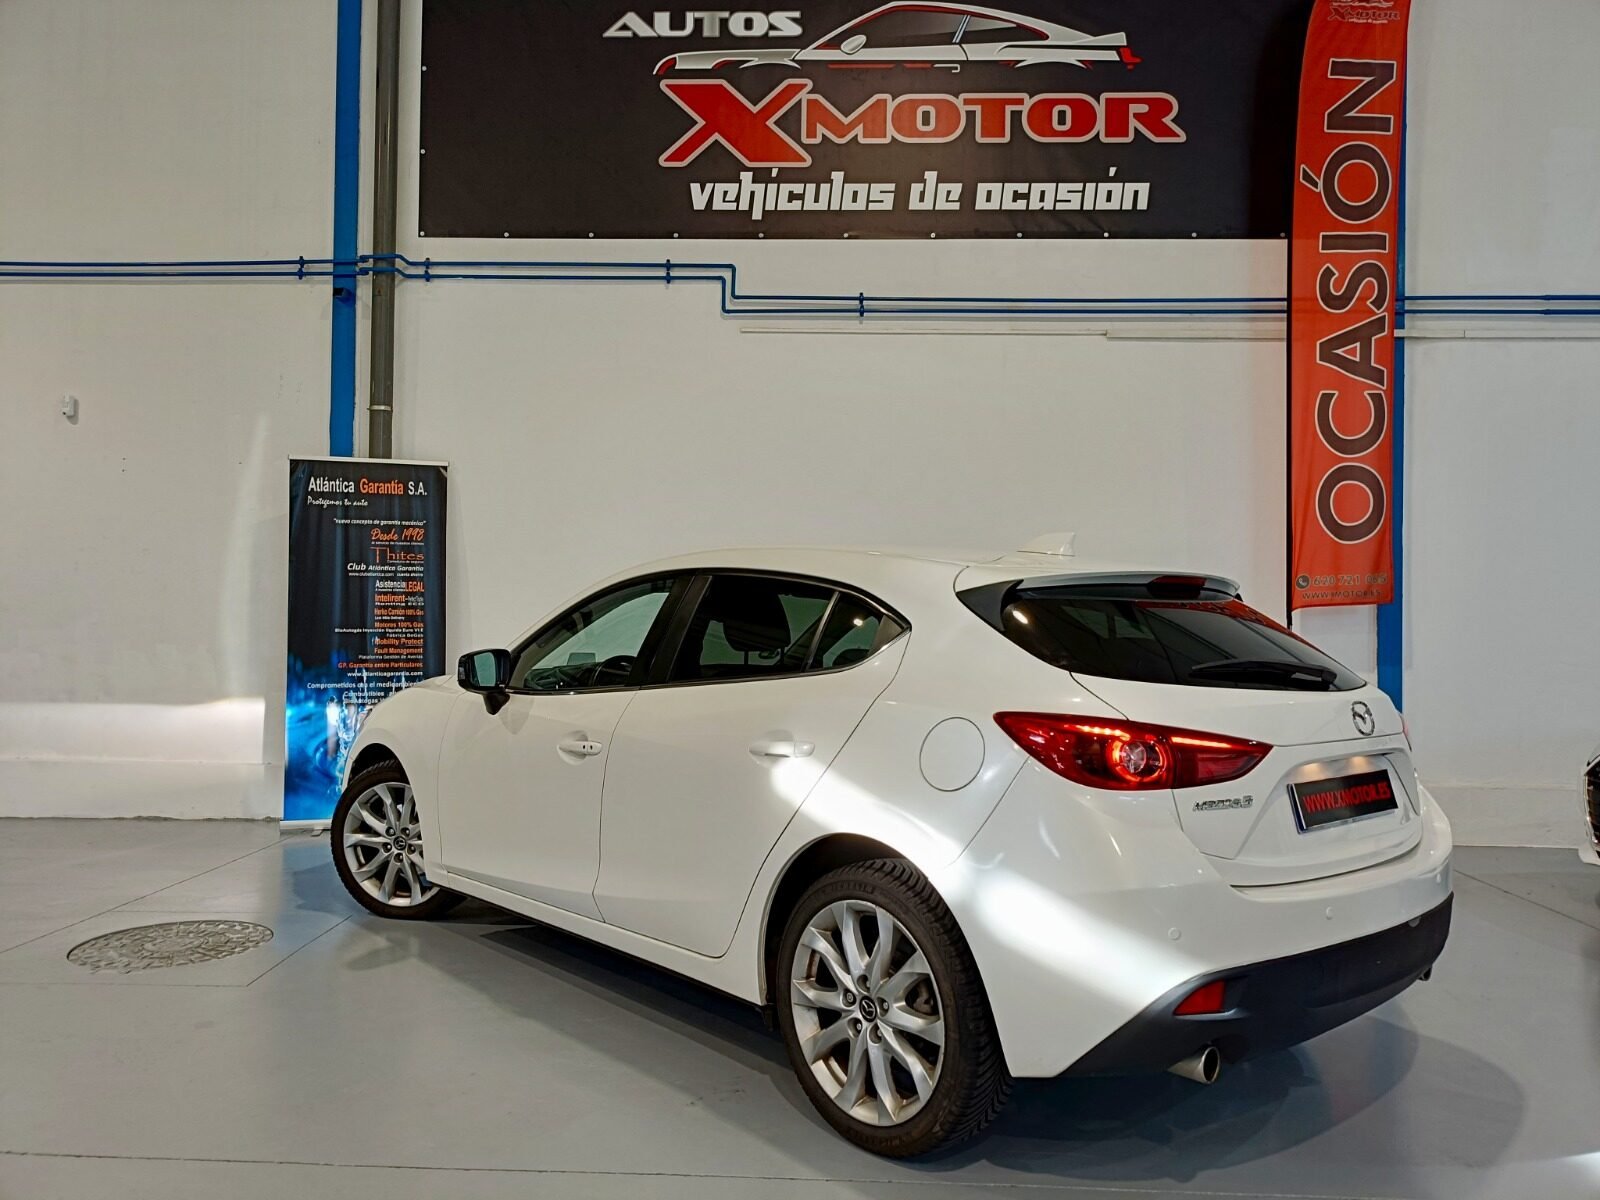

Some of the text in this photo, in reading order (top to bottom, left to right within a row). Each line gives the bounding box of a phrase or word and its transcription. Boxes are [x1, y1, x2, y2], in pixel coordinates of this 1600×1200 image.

[602, 11, 803, 37] AUTOS
[659, 79, 1186, 167] XMOTOR
[690, 167, 1150, 219] vehículos de ocasión
[1300, 58, 1397, 545] OCASIÓN
[308, 477, 427, 495] Atlántica Garantía S.A.
[307, 496, 342, 508] Protegemos
[371, 528, 424, 541] Desde 1998
[347, 563, 366, 571] Club
[1339, 574, 1361, 585] 721
